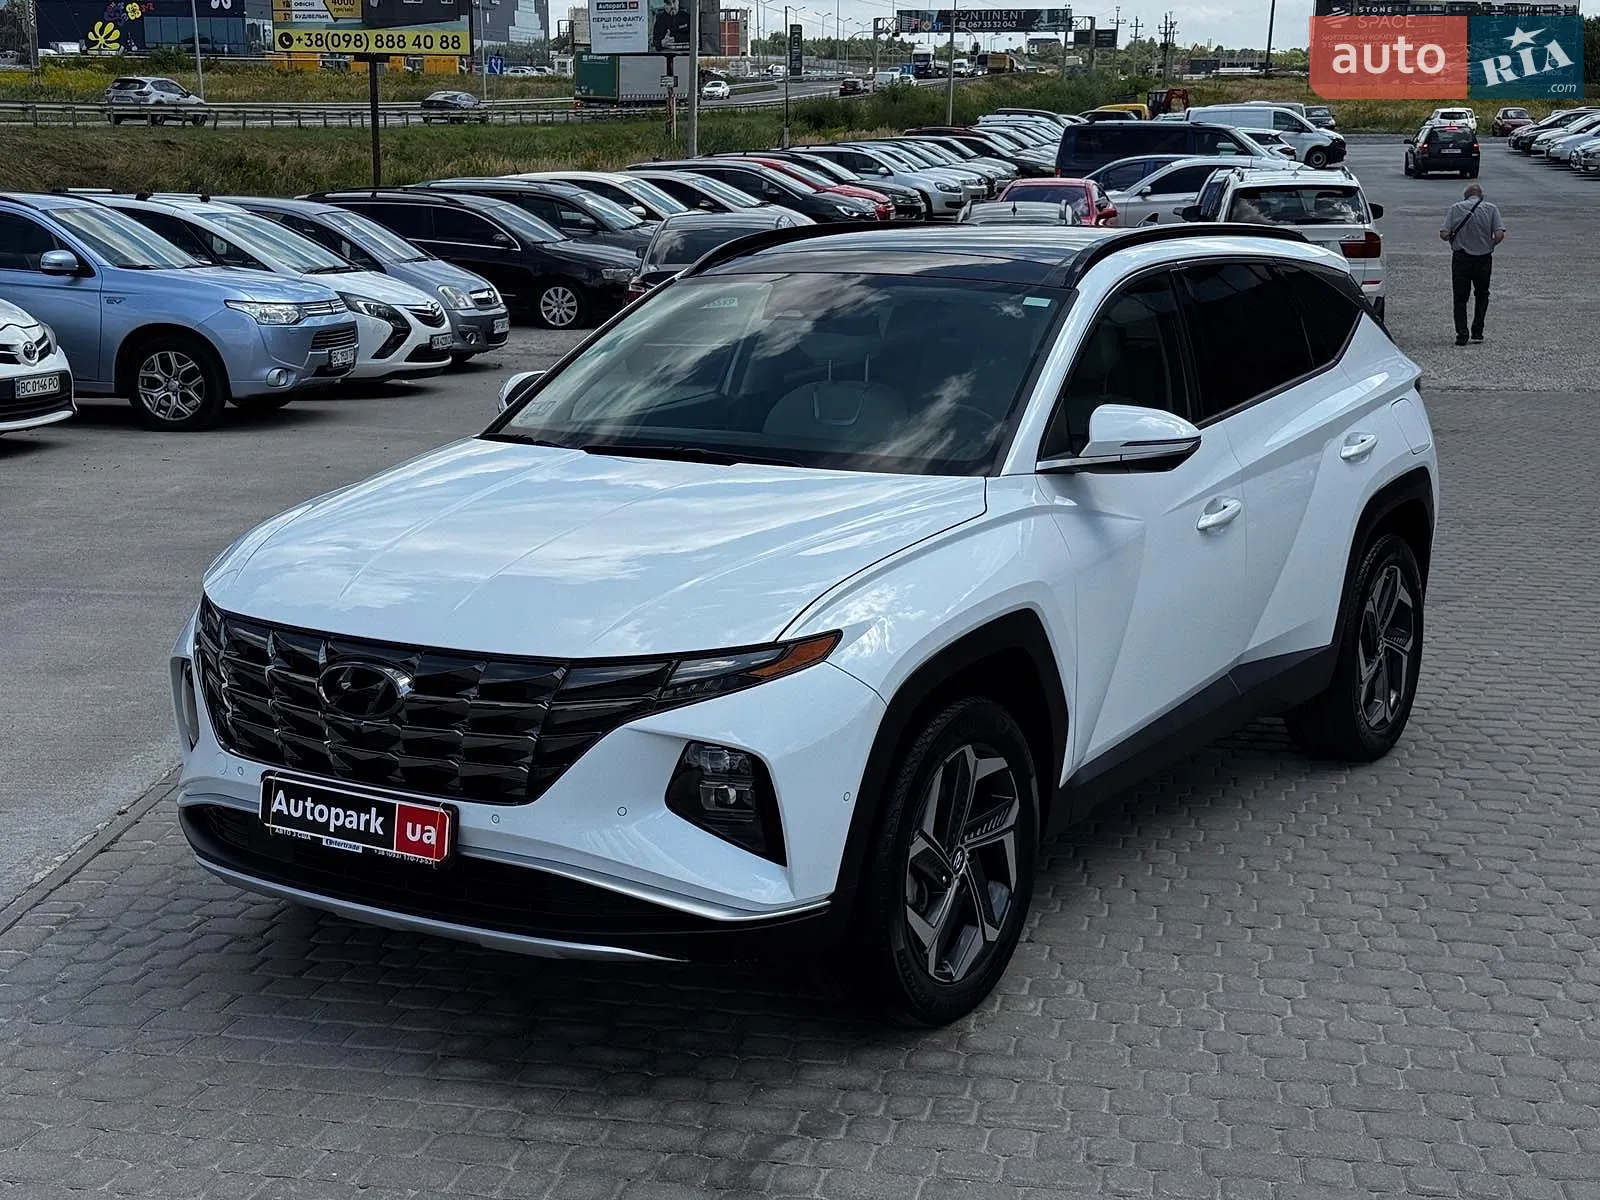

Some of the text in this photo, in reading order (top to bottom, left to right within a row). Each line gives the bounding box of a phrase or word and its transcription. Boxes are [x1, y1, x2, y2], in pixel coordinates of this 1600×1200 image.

[1357, 15, 1416, 28] SPACE
[295, 31, 461, 52] +38(098) 888 40 88
[20, 381, 32, 394] BC
[31, 379, 48, 392] 0146
[271, 789, 437, 846] Autopark ua
